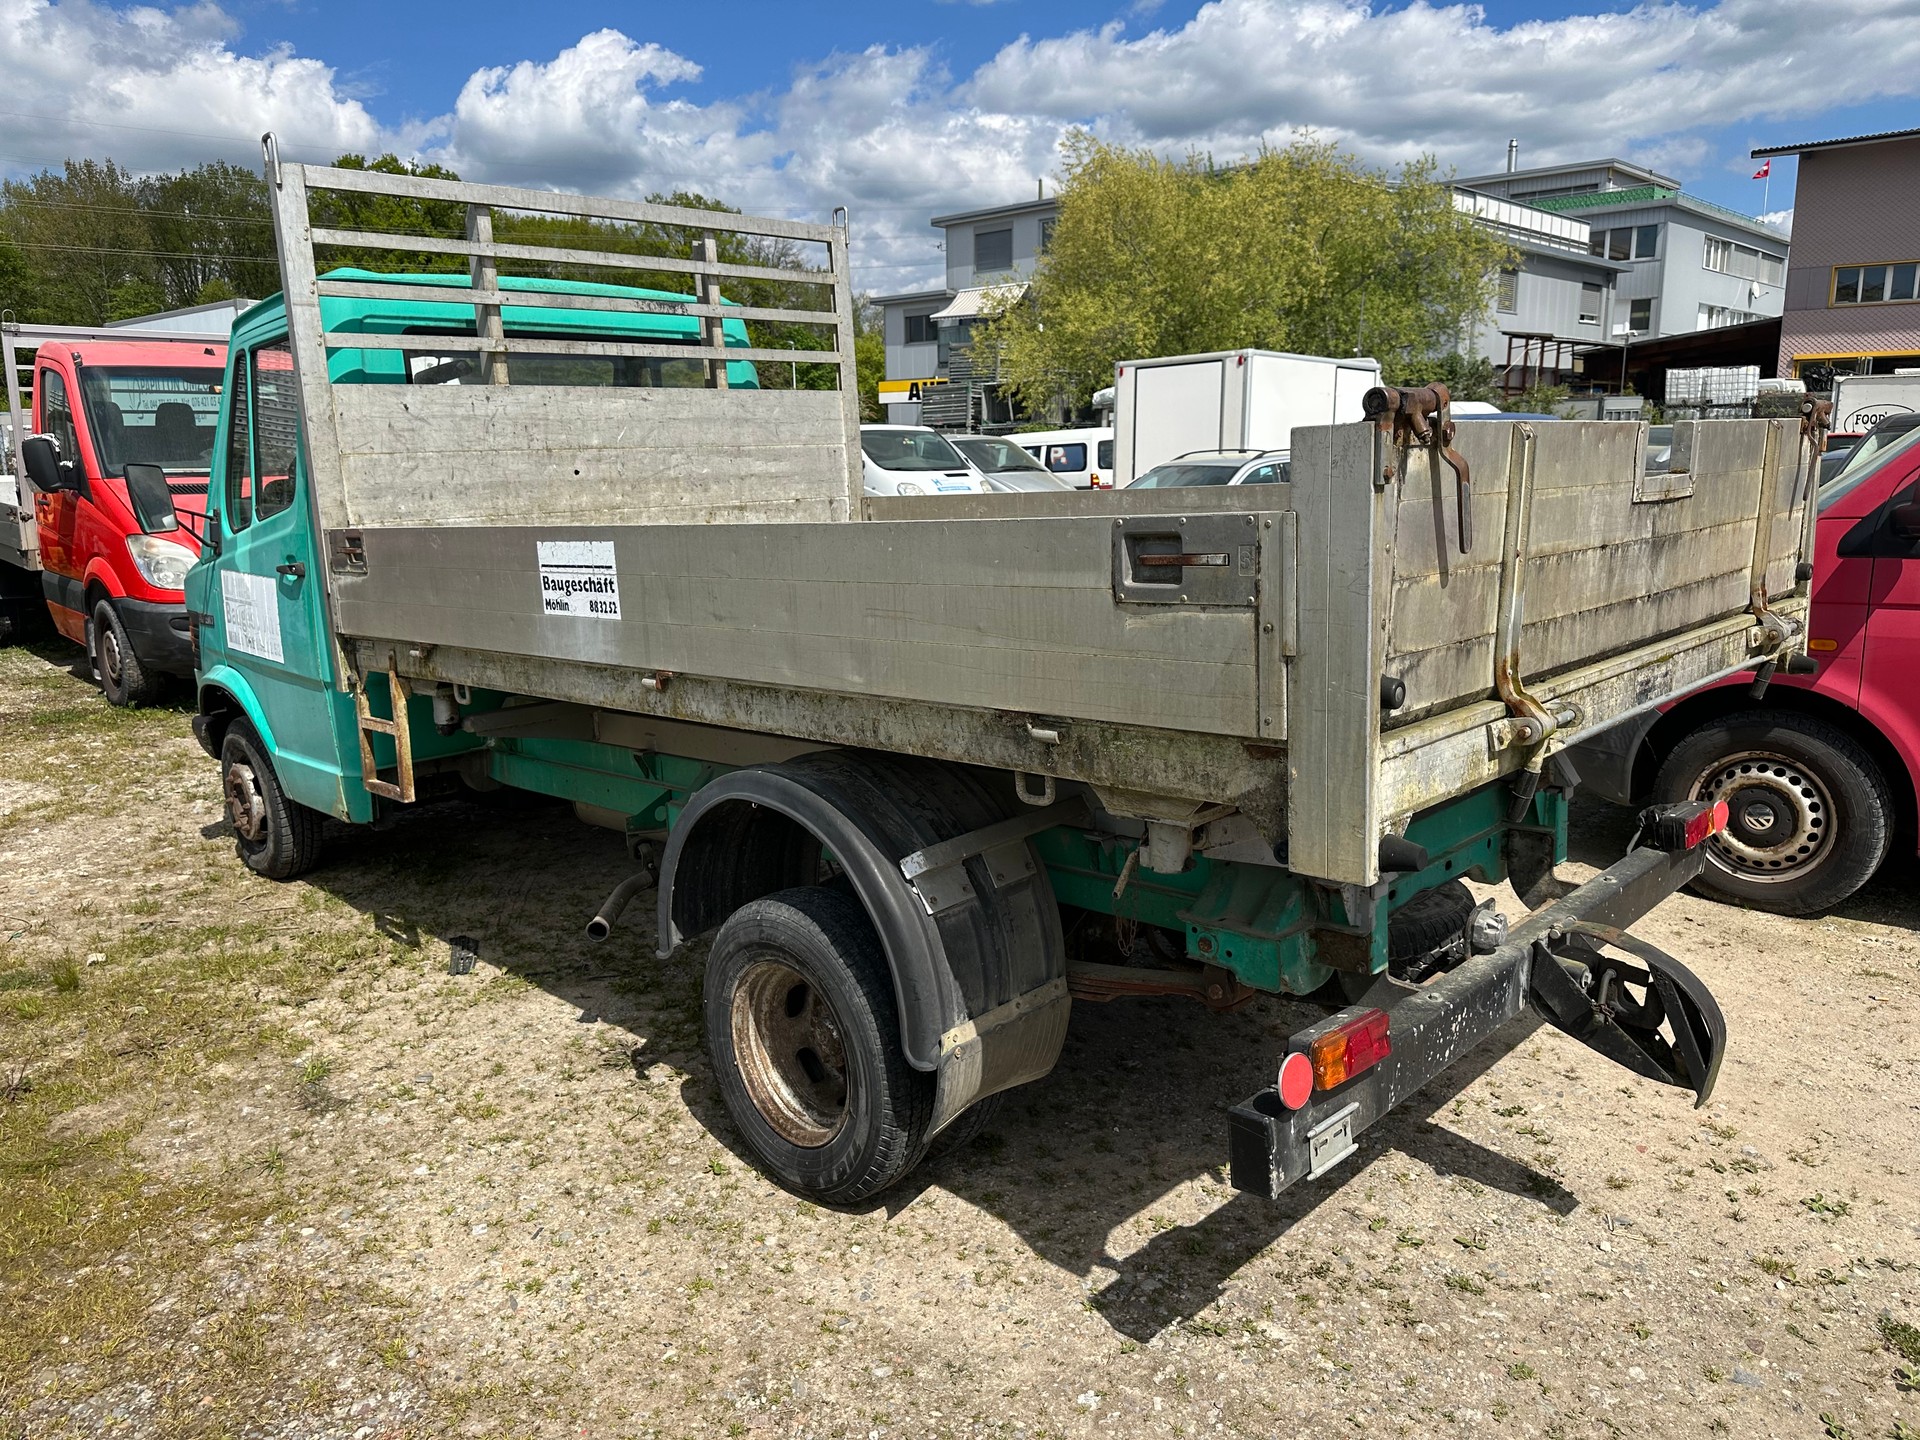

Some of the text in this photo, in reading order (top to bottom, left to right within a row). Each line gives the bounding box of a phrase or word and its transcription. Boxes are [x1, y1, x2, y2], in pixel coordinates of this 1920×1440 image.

[542, 575, 615, 596] Baugeschäft
[545, 598, 618, 614] Möhlin 883252
